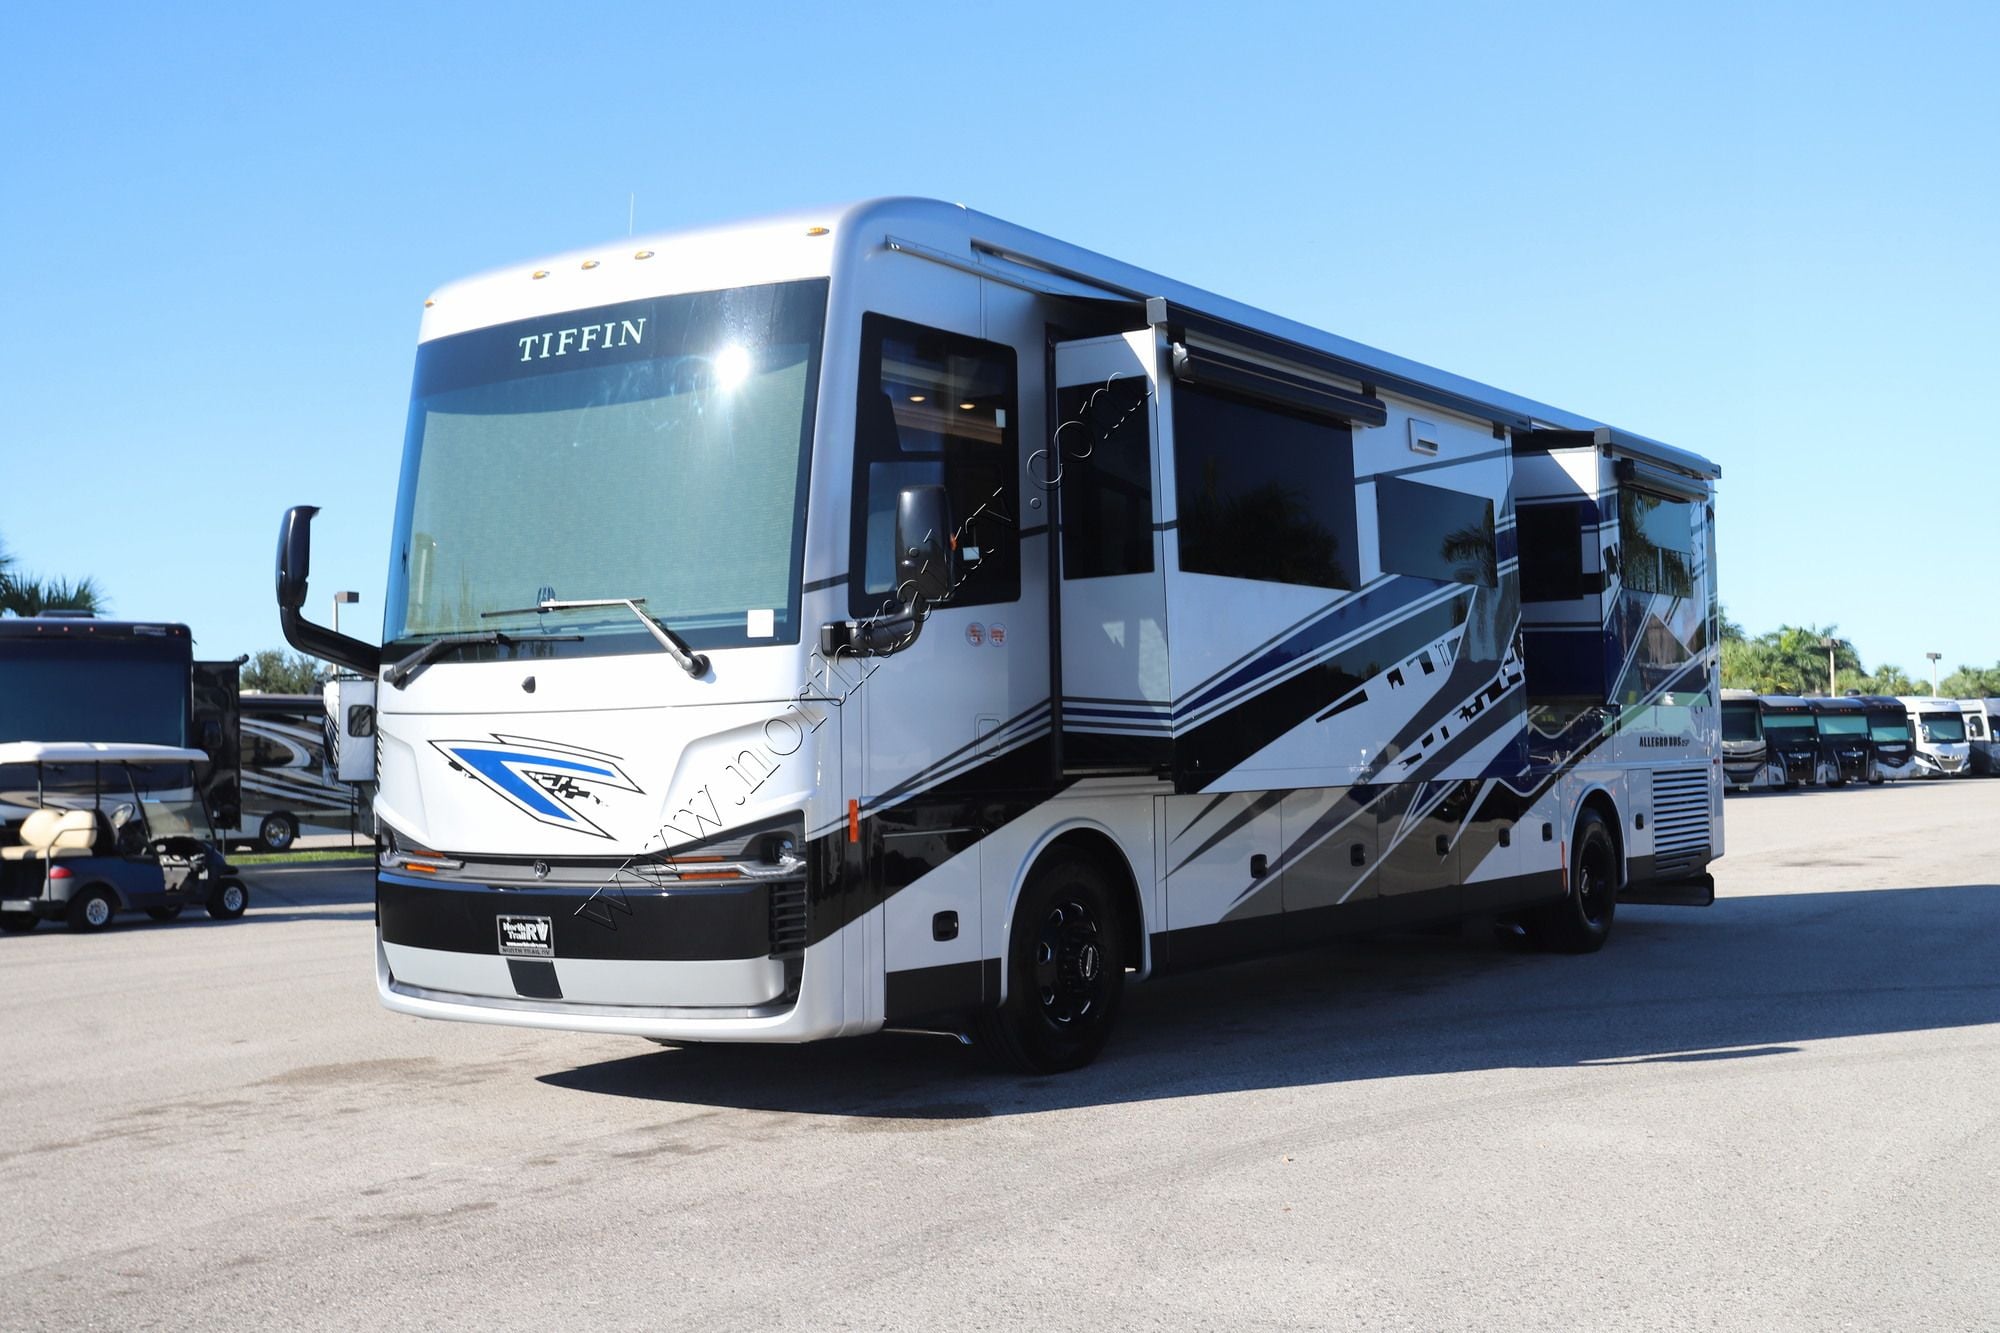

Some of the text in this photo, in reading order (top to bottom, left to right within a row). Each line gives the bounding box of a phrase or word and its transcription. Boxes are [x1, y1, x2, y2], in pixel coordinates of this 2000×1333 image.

[519, 318, 646, 362] TIFFIN
[1640, 736, 1668, 747] ALLEGRO
[503, 922, 526, 931] North
[526, 922, 548, 941] RV
[508, 931, 526, 940] Trail
